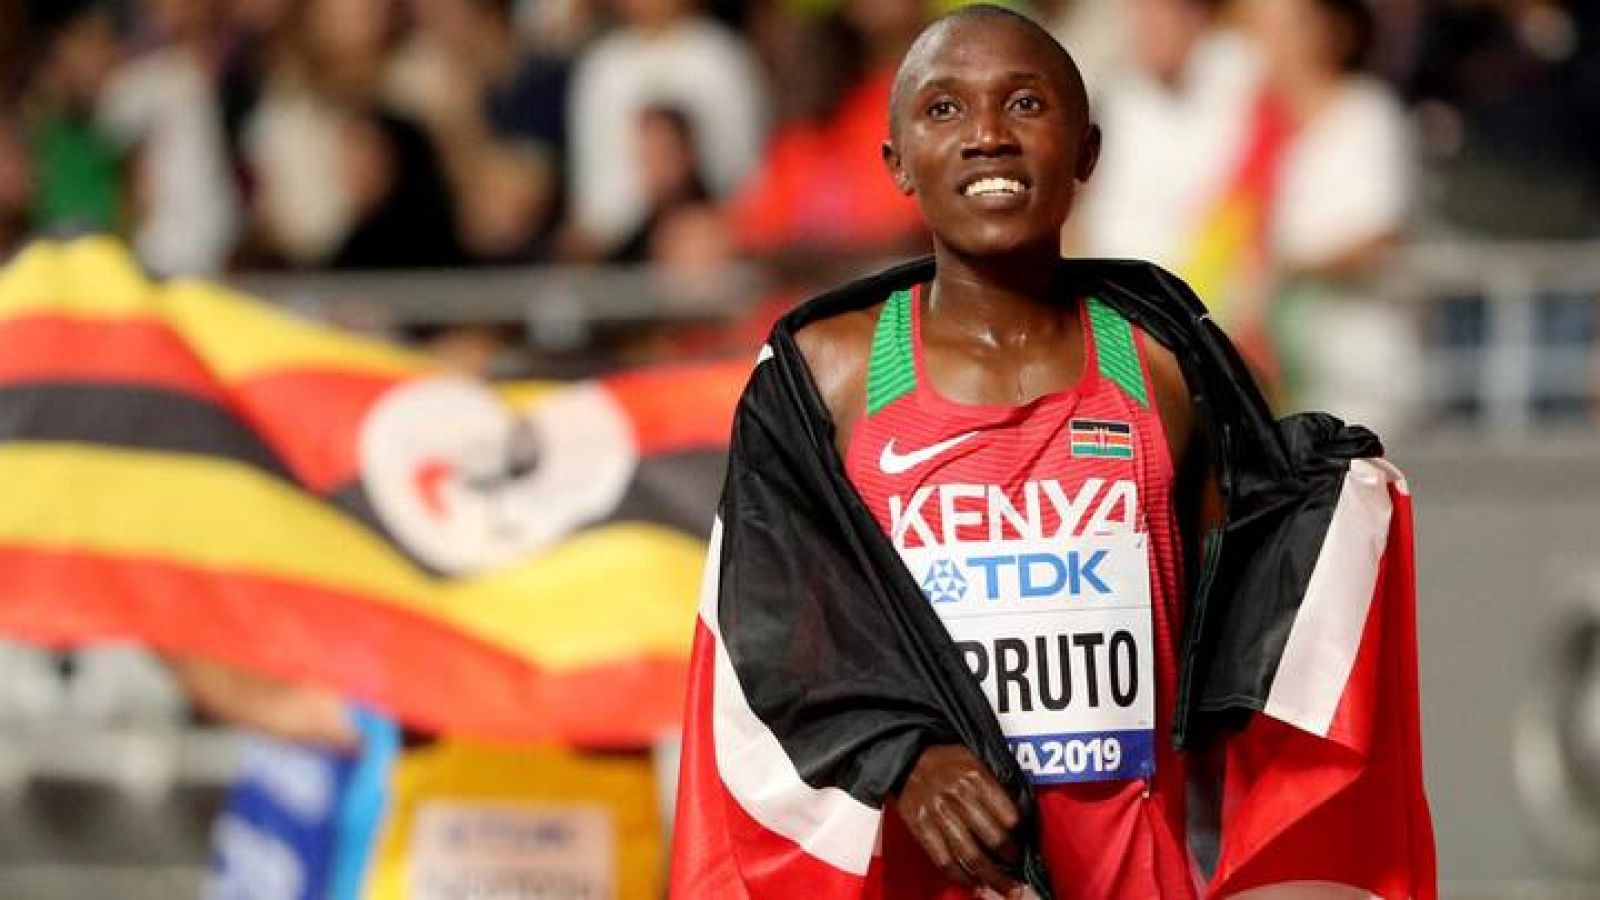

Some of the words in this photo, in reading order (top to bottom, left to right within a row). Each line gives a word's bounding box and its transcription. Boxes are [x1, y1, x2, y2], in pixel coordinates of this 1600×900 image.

[888, 479, 1138, 549] KENYA
[966, 550, 1113, 601] TDK
[1008, 738, 1121, 775] A2019
